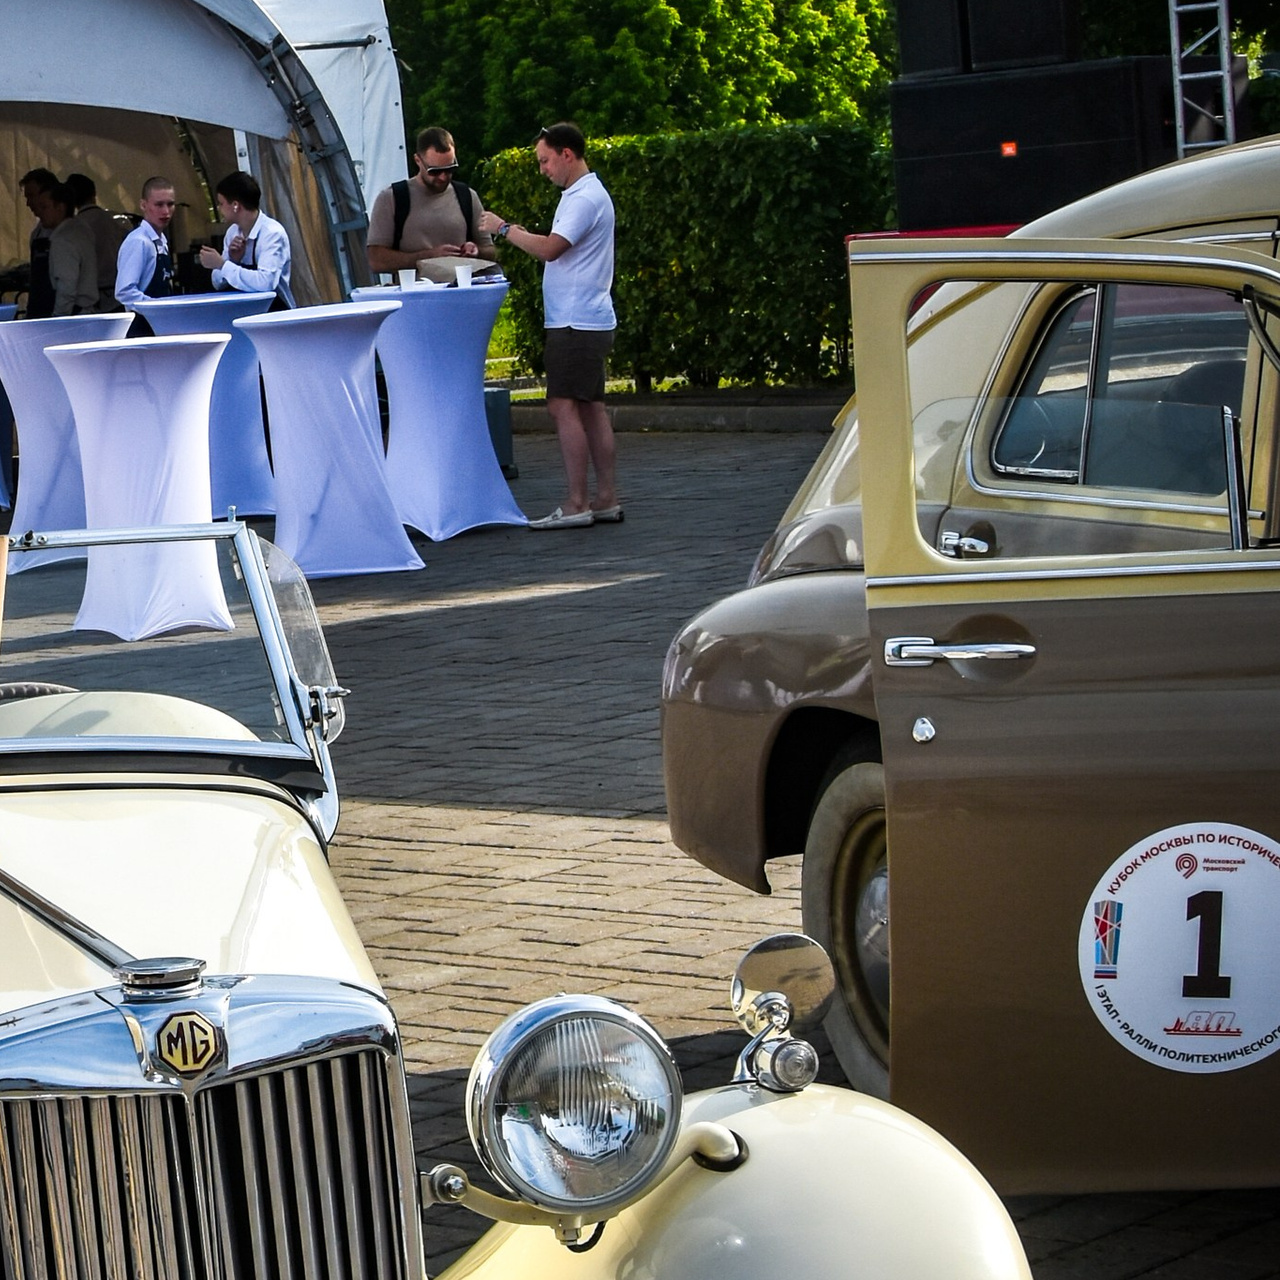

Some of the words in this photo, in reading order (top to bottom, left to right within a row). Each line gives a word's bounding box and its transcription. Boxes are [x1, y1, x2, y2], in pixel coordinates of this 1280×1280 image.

[1107, 858, 1142, 895] КУБОК
[1140, 834, 1194, 863] МОСКВЫ
[1197, 833, 1216, 843] ПО
[1218, 834, 1280, 869] ИСТОРИЧЕ
[1182, 890, 1231, 998] 1
[166, 1020, 211, 1066] MG
[1097, 989, 1119, 1019] ЭТАП
[1120, 1021, 1158, 1052] РАЛЛИ
